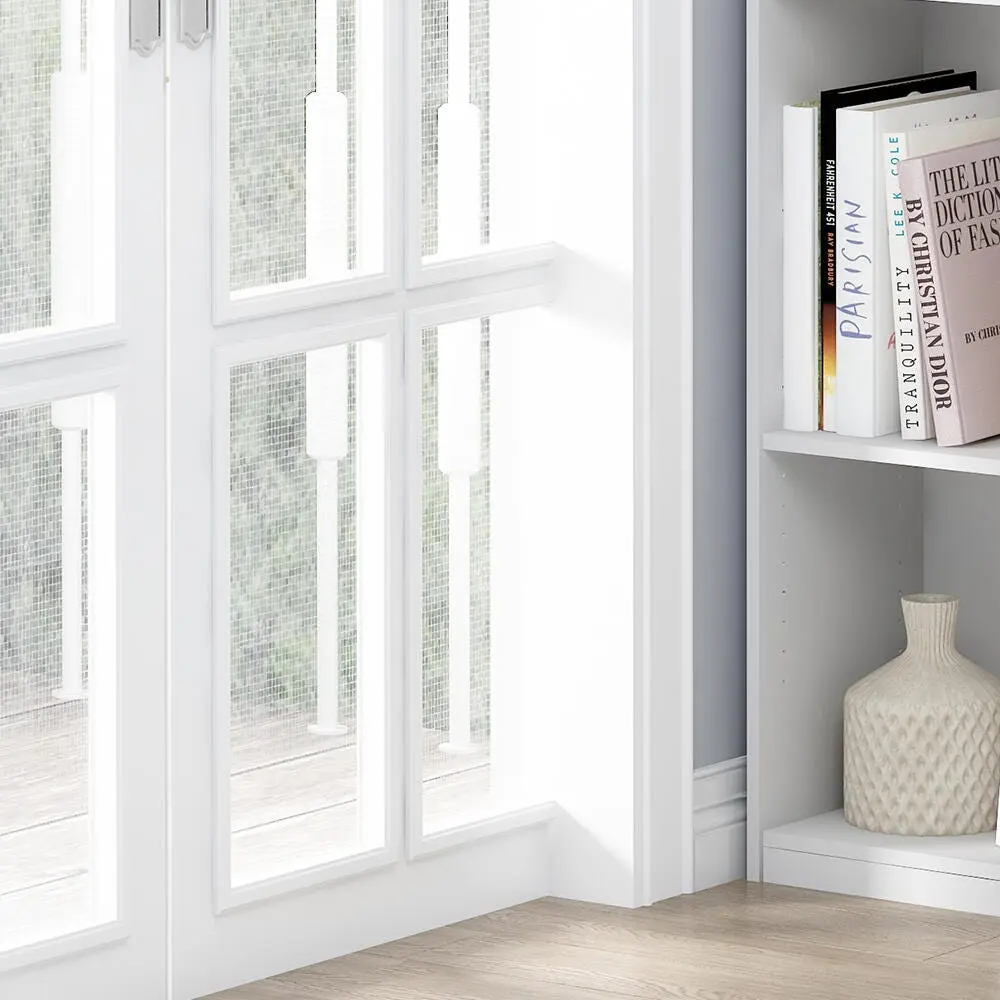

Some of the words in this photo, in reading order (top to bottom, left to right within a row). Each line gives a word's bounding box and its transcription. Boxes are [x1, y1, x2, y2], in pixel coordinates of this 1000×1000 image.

[825, 159, 836, 210] FAHRENHEIT
[928, 168, 970, 197] THE
[826, 211, 836, 226] 451
[893, 209, 905, 237] LEE
[905, 197, 926, 228] BY
[939, 228, 962, 259] OF
[835, 199, 872, 340] PARISIAN
[910, 235, 944, 349] CHRISTIAN
[895, 265, 920, 429] TRANQUILITY
[964, 331, 977, 344] BY
[928, 352, 953, 411] DIOR
